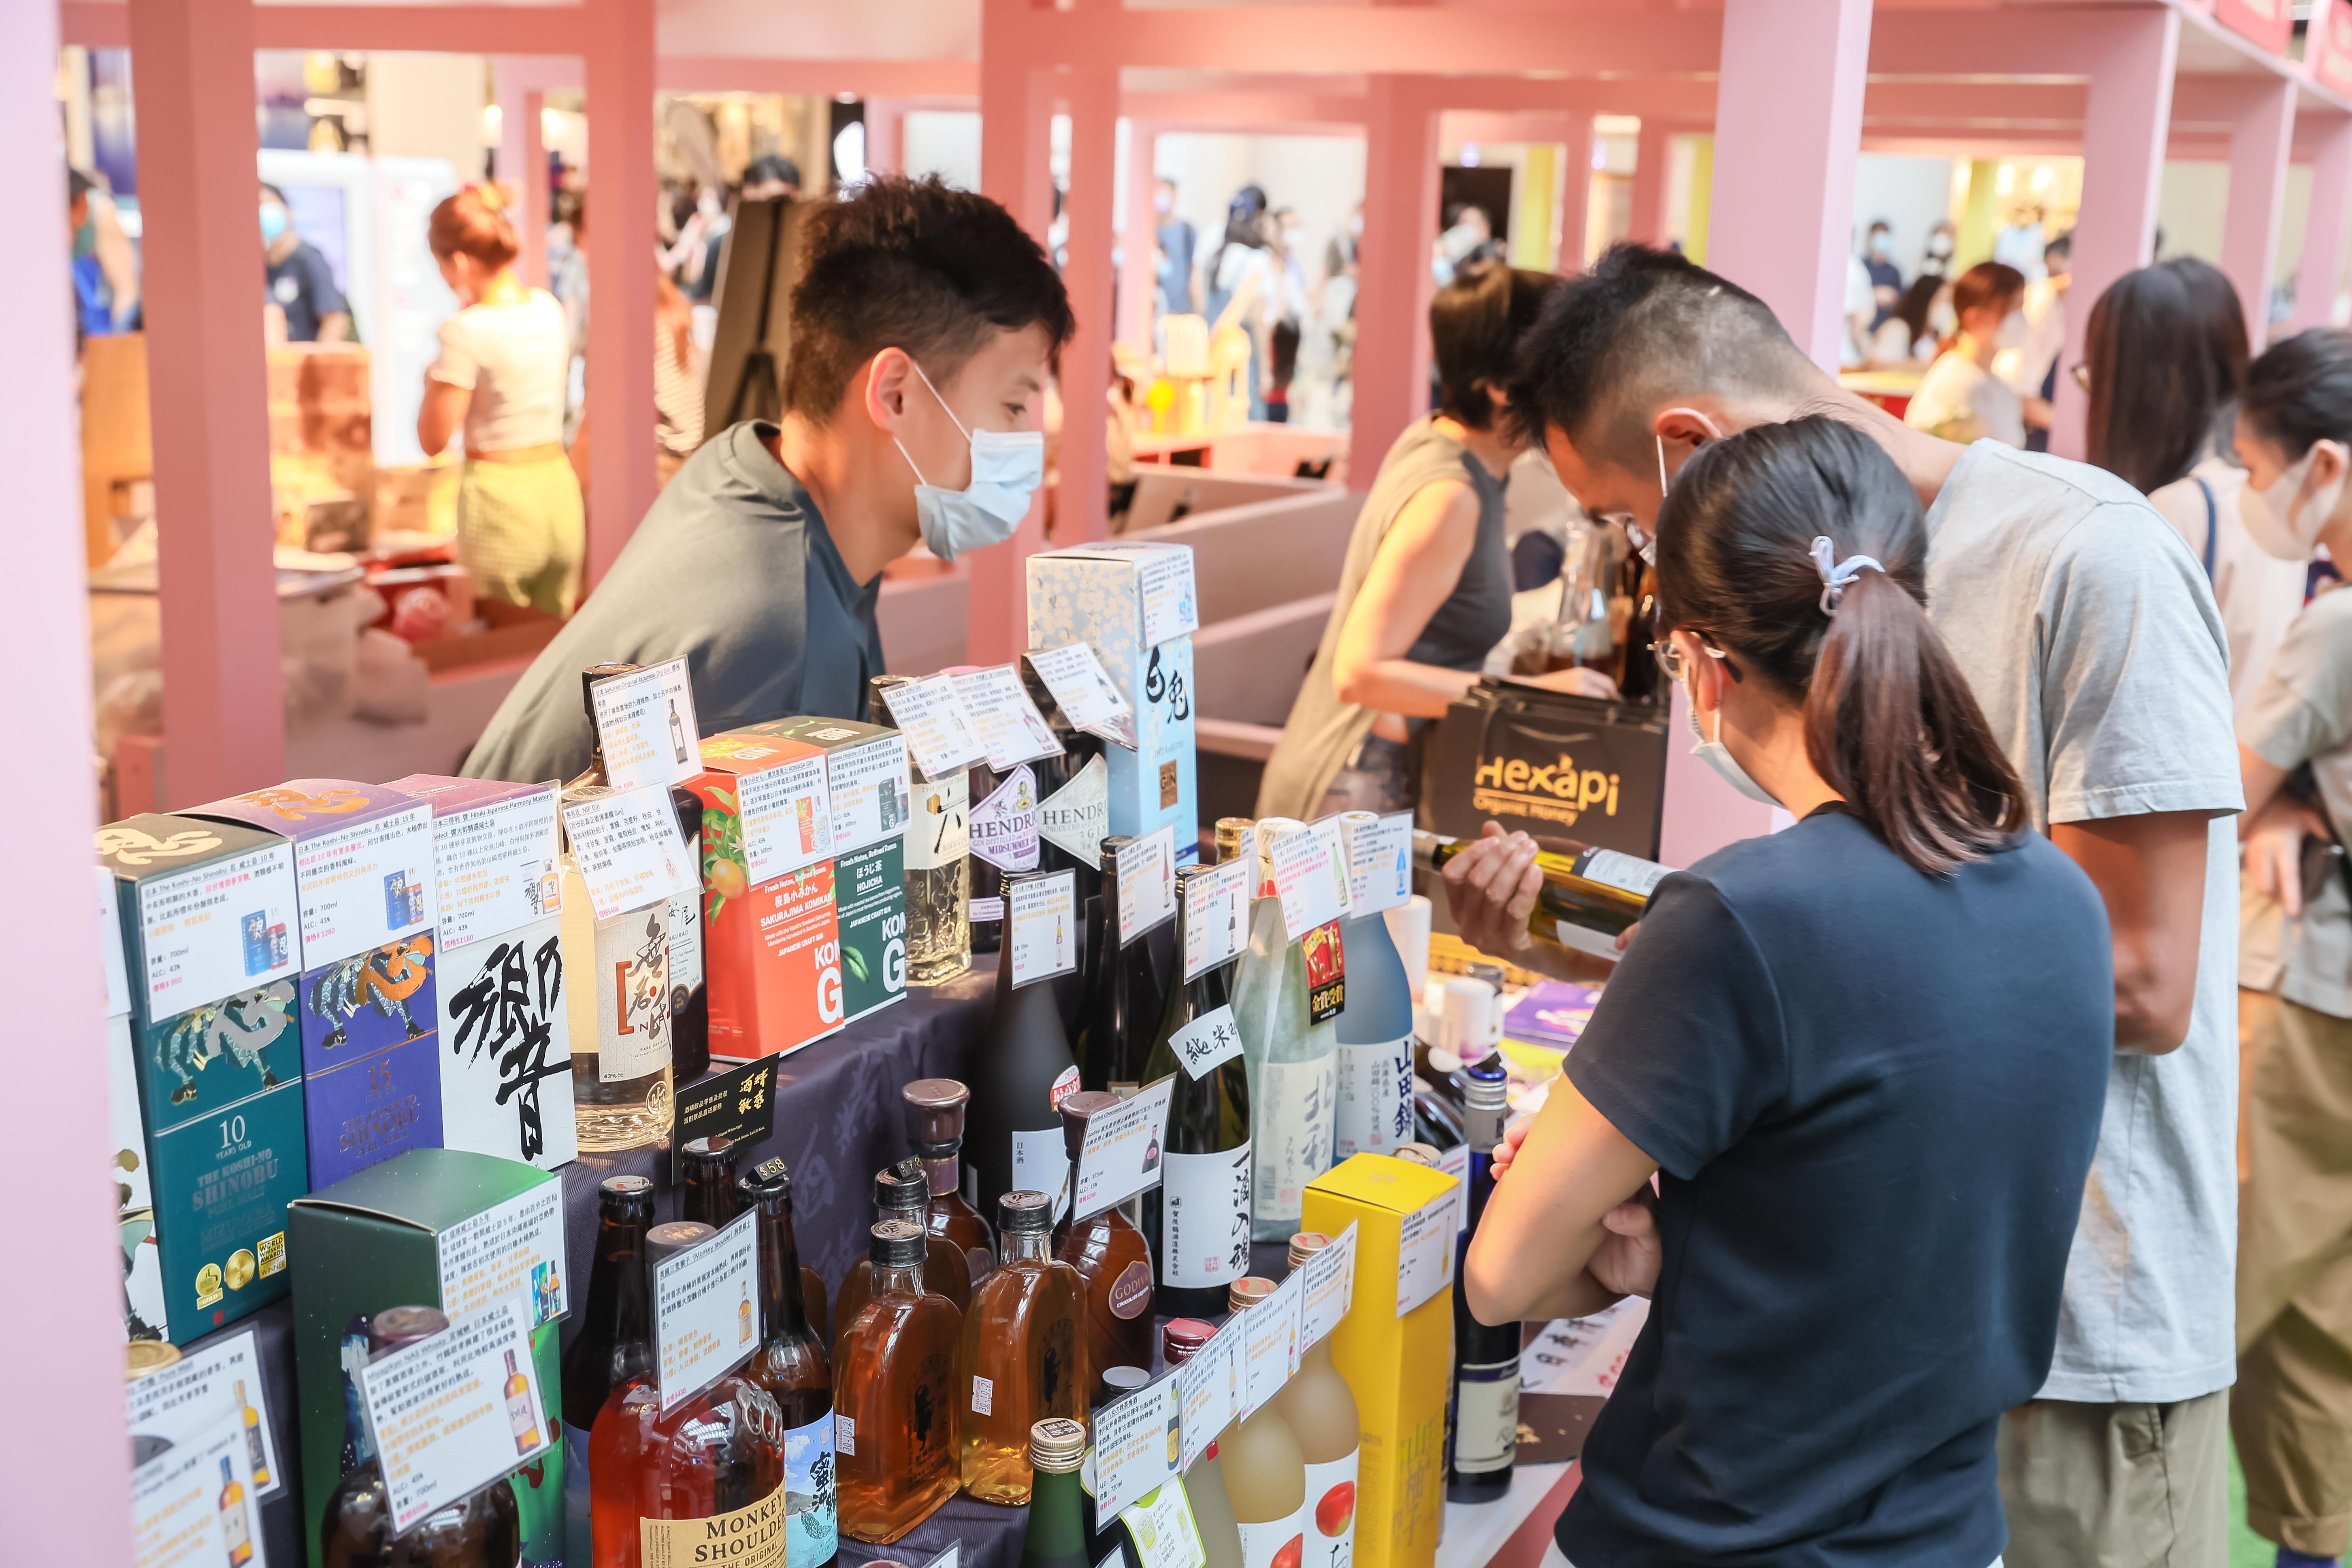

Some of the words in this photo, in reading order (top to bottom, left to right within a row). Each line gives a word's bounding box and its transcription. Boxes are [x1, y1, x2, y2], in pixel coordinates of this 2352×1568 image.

[605, 684, 620, 693] Sakurao
[622, 678, 637, 688] Original
[639, 673, 655, 682] Japanese
[788, 763, 805, 772] KOMASA
[1475, 753, 1620, 817] Hexapi
[487, 804, 509, 815] Japanese
[510, 799, 531, 809] Harmony
[566, 809, 580, 818] 無名氏
[1473, 796, 1527, 818] Organic
[1529, 806, 1578, 826] Honey
[298, 845, 310, 854] 日本
[311, 841, 321, 850] The
[323, 835, 349, 846] Koshi-No
[350, 828, 372, 838] Shinobu
[383, 818, 400, 829] 威士忌
[434, 832, 448, 840] Select
[1046, 824, 1079, 833] PRODUCED
[986, 835, 1015, 845] DISTILLED
[989, 838, 1029, 854] MIDSUMMER
[840, 859, 854, 868] Fresh
[854, 854, 868, 864] Notes,
[868, 848, 884, 858] Refined
[884, 842, 897, 852] Tones
[204, 868, 227, 880] Shinobu
[856, 860, 882, 879] ほうじ茶
[765, 882, 779, 893] Fresh
[779, 878, 795, 889] Notes,
[795, 871, 812, 882] Refined
[813, 866, 826, 876] Tones
[856, 875, 882, 892] HOJICHA
[775, 882, 818, 908] 桜島小みかん
[320, 901, 337, 912] 700ml
[458, 910, 474, 920] 700ml
[761, 905, 803, 927] SAKURAJIMA
[805, 893, 832, 910] KOMIKAN
[849, 914, 871, 928] JAPANESE
[871, 909, 884, 920] CRAFT
[322, 928, 334, 937] 1280
[806, 925, 820, 933] Southern
[778, 942, 801, 957] JAPANESE
[801, 937, 816, 948] CRAFT
[368, 1059, 390, 1091] 15
[739, 1068, 768, 1093] 酒精
[684, 1090, 728, 1114] 酒精飲品零售及批發
[738, 1089, 764, 1114] 敏感
[343, 1114, 365, 1131] THE
[369, 1094, 416, 1120] KOSHI-NO
[684, 1103, 722, 1125] 派對飲品直送服務
[1091, 1114, 1103, 1123] Godiva
[1104, 1106, 1122, 1116] Chocolate
[1122, 1101, 1135, 1110] Liqueur
[220, 1115, 245, 1148] 10
[340, 1104, 420, 1153] SHINOBU
[1087, 1129, 1100, 1138] Godiva
[216, 1147, 236, 1159] YEARS
[239, 1140, 251, 1151] OLD
[356, 1142, 380, 1158] PURE
[1016, 1142, 1024, 1164] 日本酒
[197, 1171, 219, 1188] THE
[222, 1148, 272, 1175] KOSHI-NO
[759, 1159, 785, 1177] $58
[901, 1157, 922, 1173] $78
[1092, 1170, 1104, 1179] 375ml
[192, 1159, 278, 1211] SHINOBU
[208, 1197, 233, 1219] PURE
[260, 1243, 284, 1257] WHISKIES
[261, 1249, 284, 1264] AWARDS
[262, 1260, 285, 1276] WINNER
[1115, 1272, 1148, 1300] GODIVA
[202, 1293, 218, 1305] GOLD
[1208, 1336, 1219, 1348] Lychee
[1219, 1326, 1231, 1339] Liqueur
[422, 1339, 445, 1355] Whisky
[1098, 1416, 1106, 1427] 福岡
[1191, 1424, 1199, 1437] 720ml
[1034, 1427, 1049, 1439] Hombo
[1111, 1480, 1123, 1492] 720ml
[1100, 1496, 1116, 1513] 價格$188
[705, 1489, 784, 1540] MONKEY
[695, 1508, 785, 1562] SHOULDER
[1157, 1521, 1164, 1532] 加冰
[745, 1540, 778, 1566] ORIGINAL
